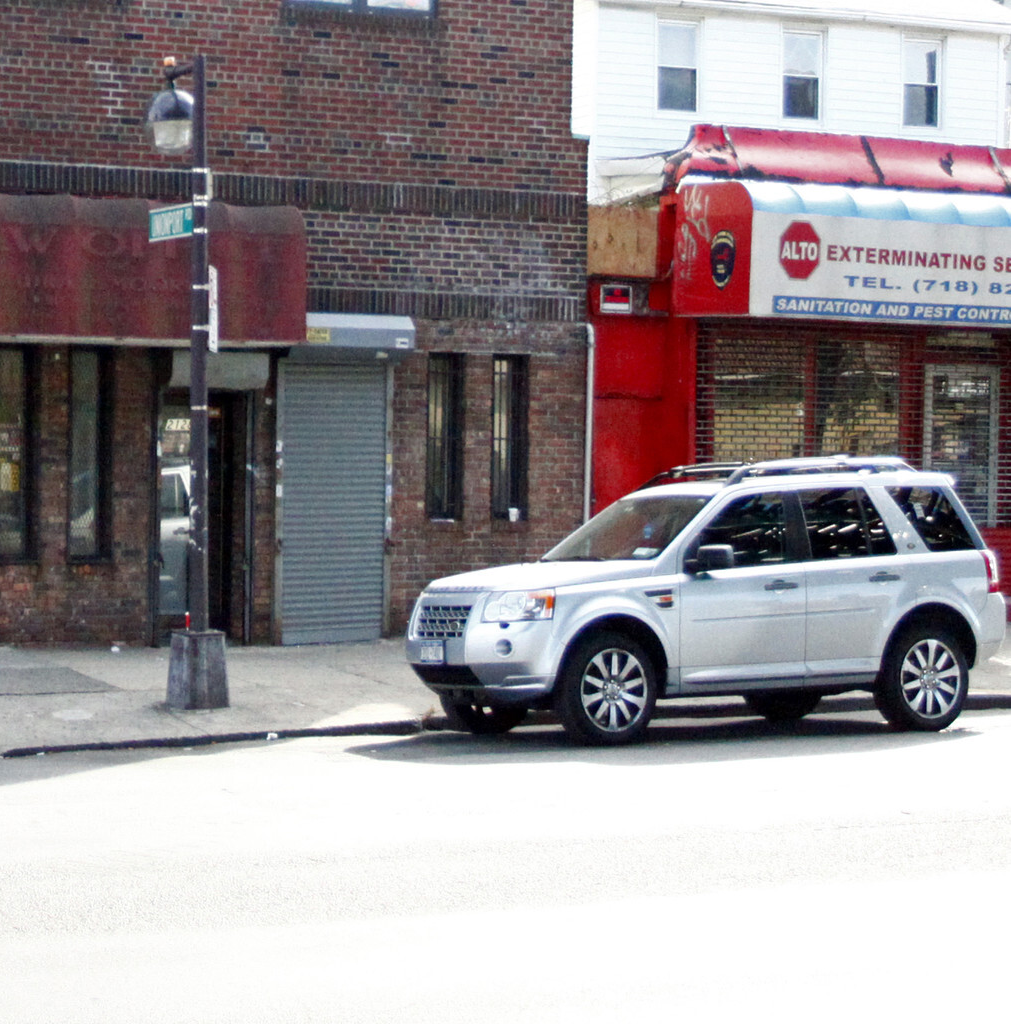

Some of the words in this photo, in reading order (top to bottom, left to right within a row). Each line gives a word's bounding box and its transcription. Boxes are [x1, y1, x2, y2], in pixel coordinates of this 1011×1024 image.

[780, 240, 818, 260] ALTO
[826, 244, 986, 272] EXTERMINATING
[843, 276, 902, 290] TEL.
[913, 280, 979, 296] (718)
[776, 298, 873, 315] SANITATION
[876, 304, 909, 317] AND
[913, 306, 953, 319] PEST
[957, 307, 1011, 322] CONTR
[166, 419, 191, 431] 212
